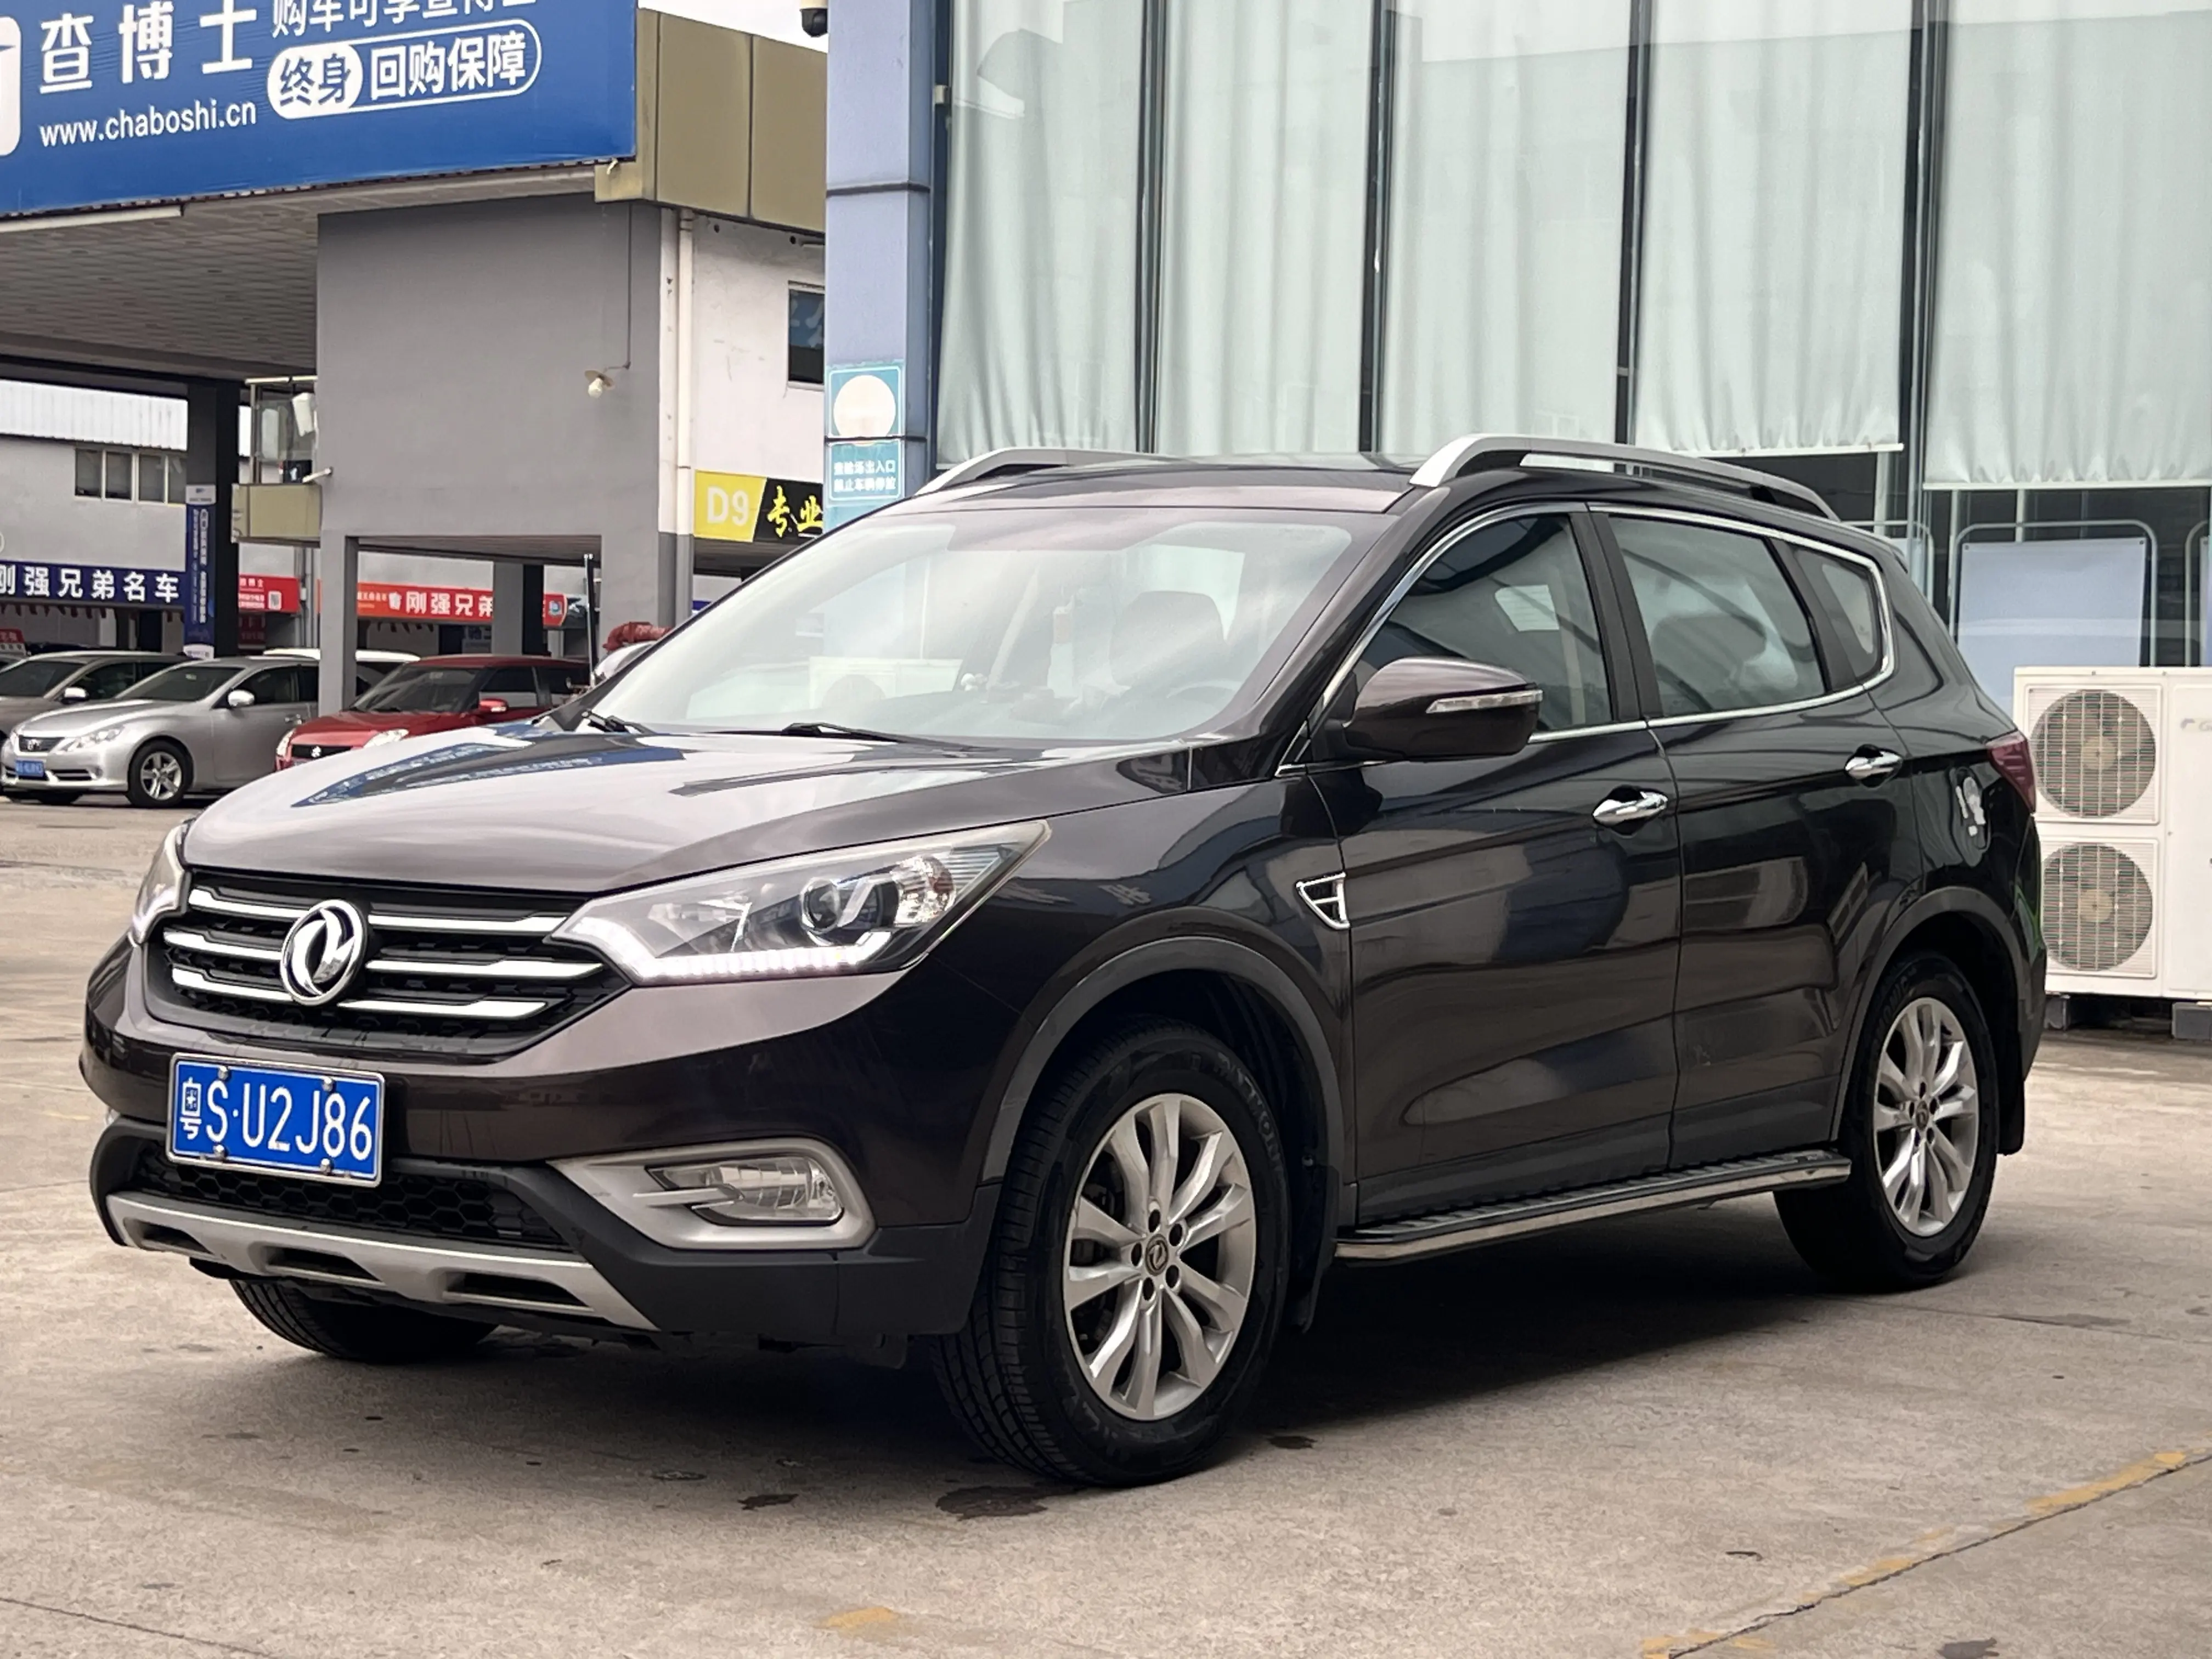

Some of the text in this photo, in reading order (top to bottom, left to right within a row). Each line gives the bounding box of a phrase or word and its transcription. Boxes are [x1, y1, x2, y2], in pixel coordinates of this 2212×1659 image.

[40, 0, 257, 94] 查博士
[279, 30, 527, 106] 终身 回购保障
[40, 98, 257, 147] www.chaboshi.cn
[707, 486, 749, 526] D9
[0, 564, 180, 603] 刚强兄弟名车
[405, 590, 493, 618] 刚强兄弟
[179, 1076, 372, 1161] 粤S·U2J86
